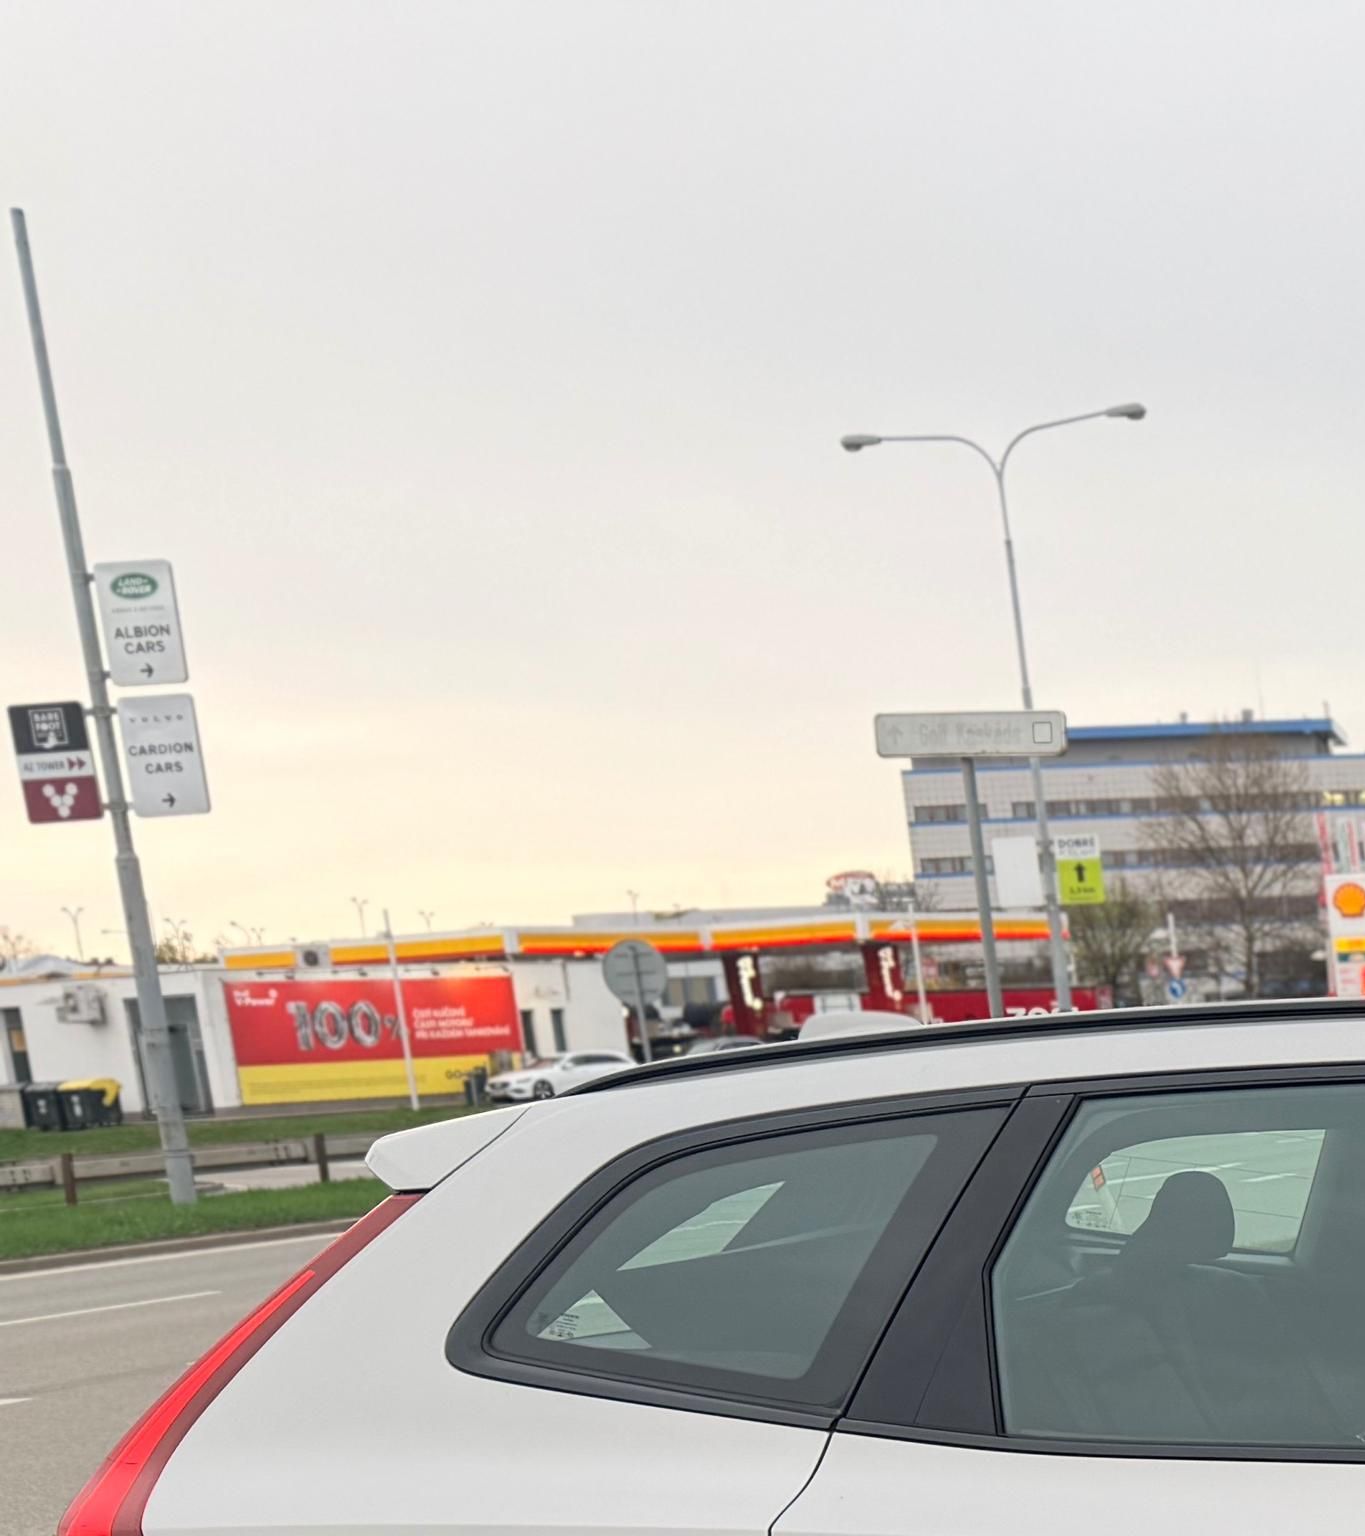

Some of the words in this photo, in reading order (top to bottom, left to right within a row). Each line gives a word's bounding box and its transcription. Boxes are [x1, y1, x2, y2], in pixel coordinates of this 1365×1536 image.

[114, 623, 171, 639] ALBION
[124, 640, 165, 655] CARS
[129, 714, 183, 723] VOLVO
[128, 742, 194, 757] CARDION
[145, 761, 183, 775] CARS
